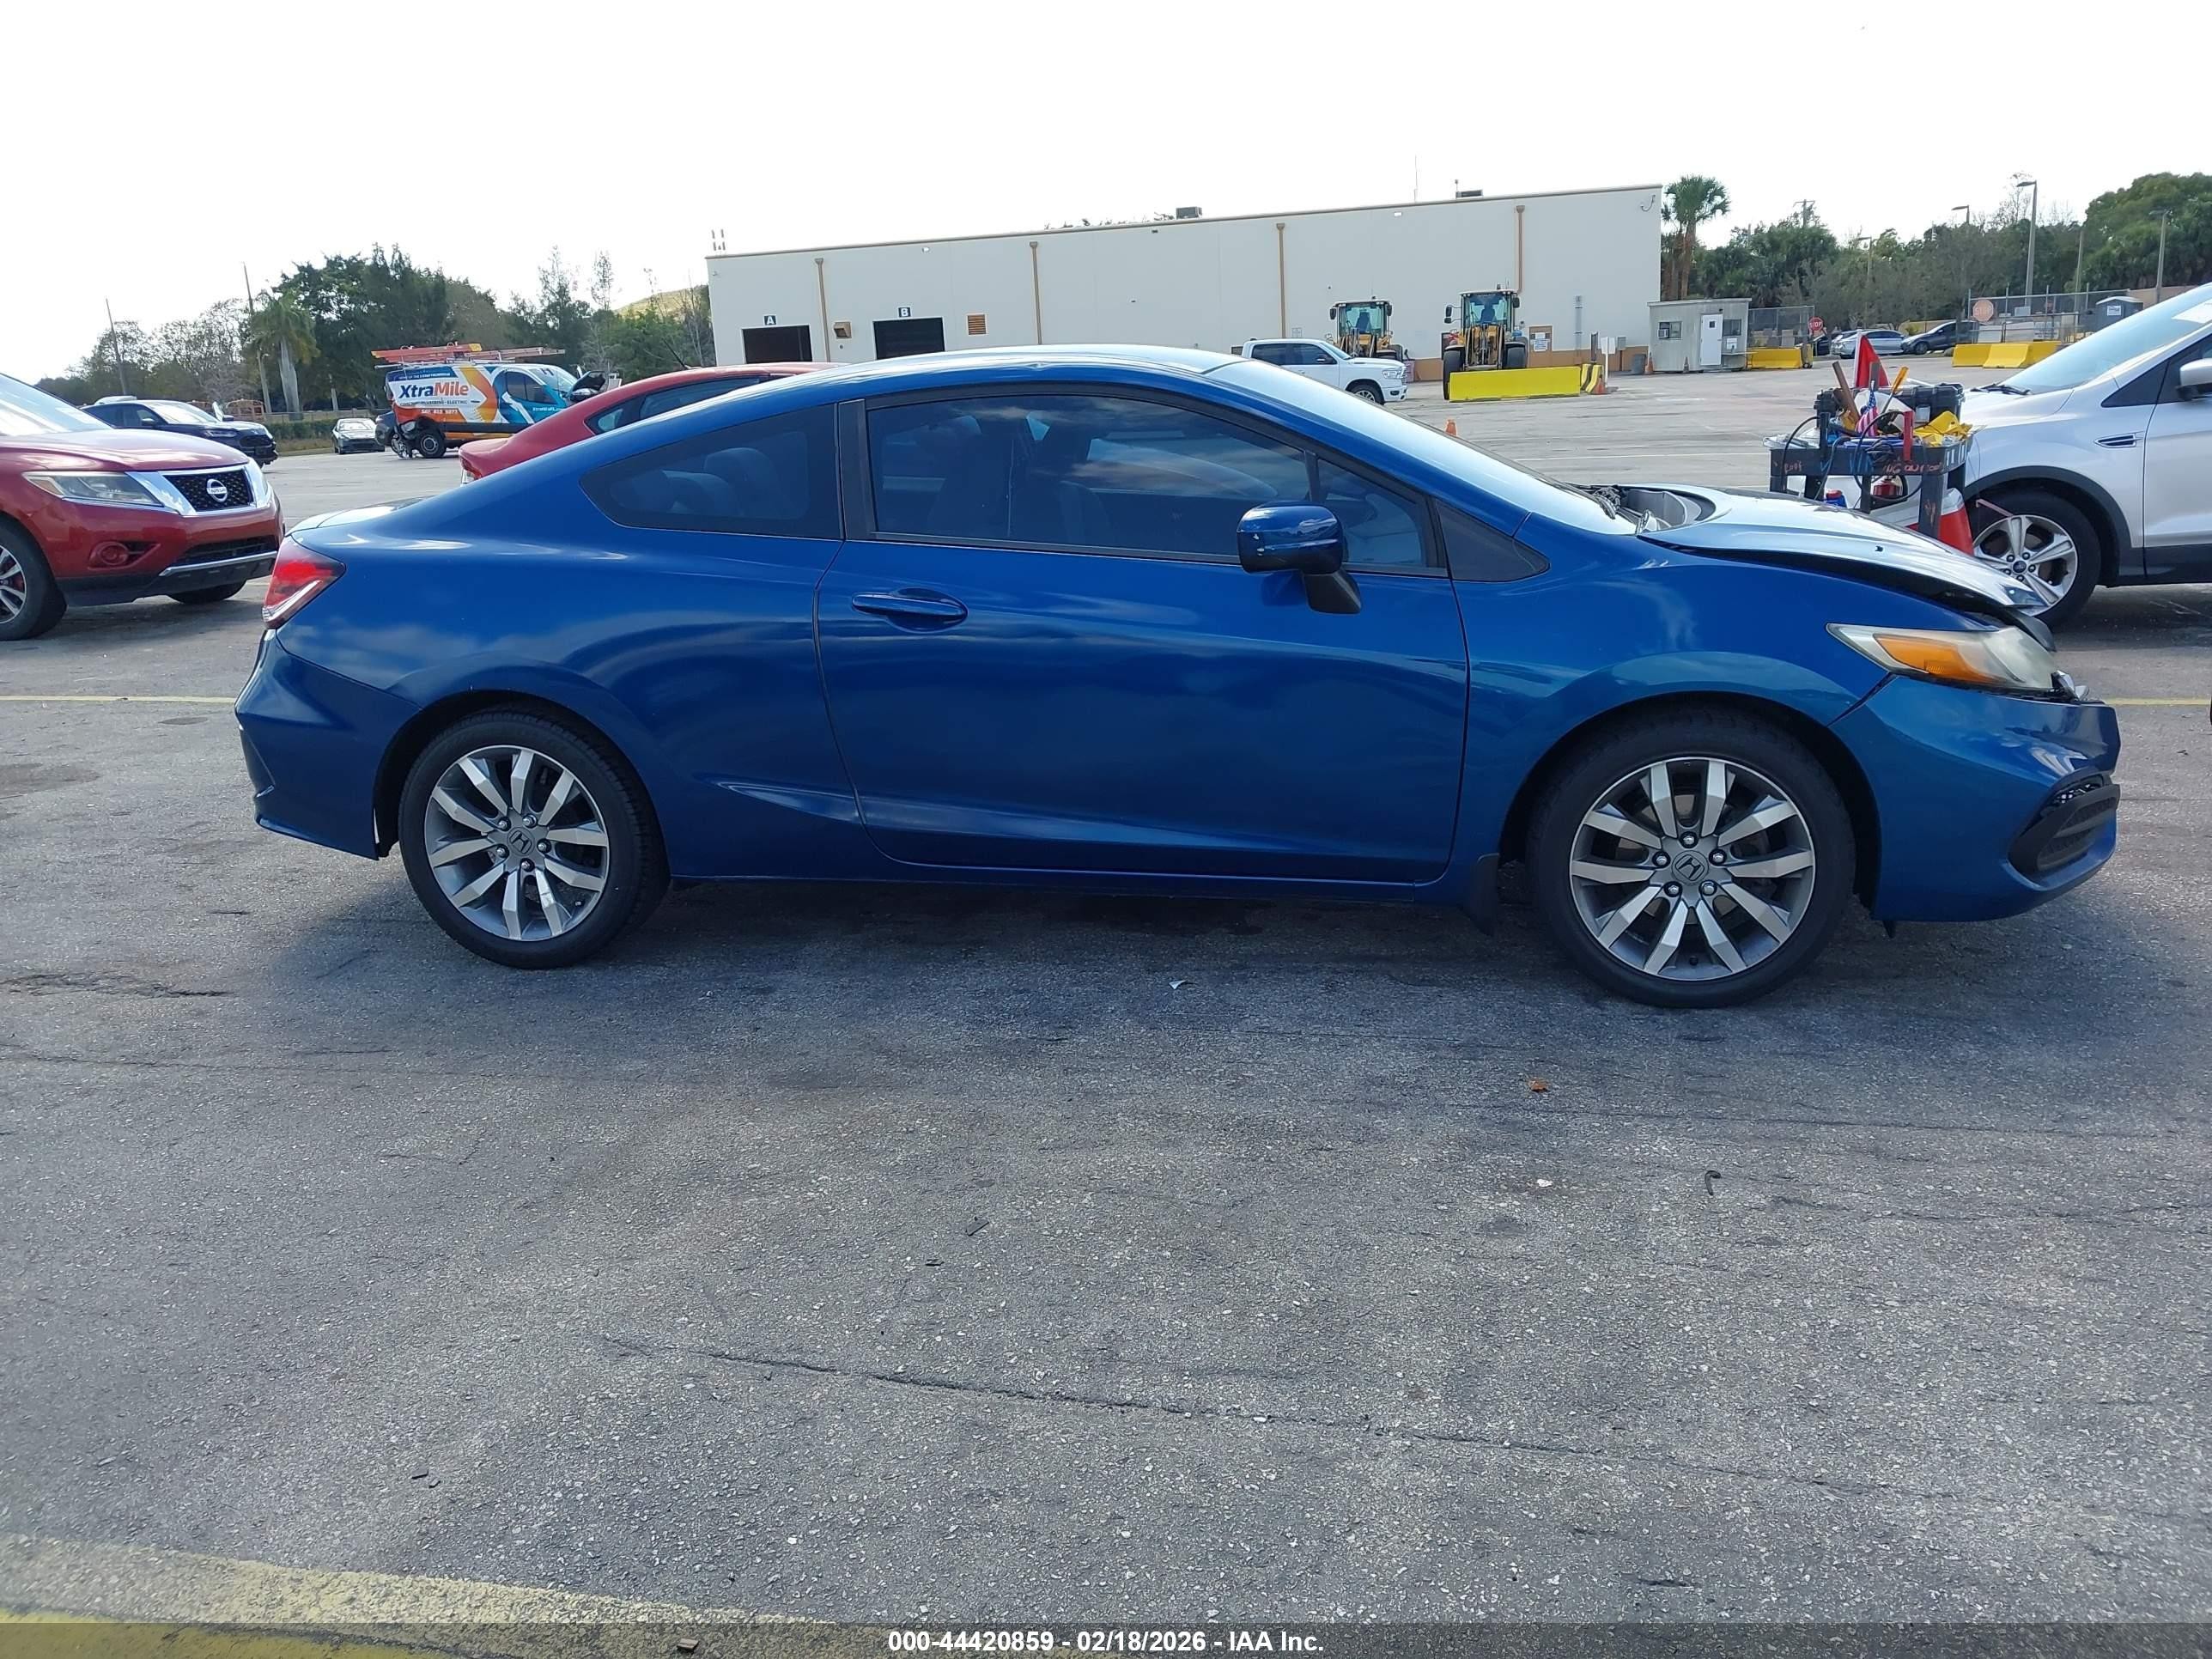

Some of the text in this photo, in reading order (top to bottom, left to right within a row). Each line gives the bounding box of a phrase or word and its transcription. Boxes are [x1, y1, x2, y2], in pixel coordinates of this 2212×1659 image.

[900, 308, 908, 317] B
[766, 315, 775, 325] A
[398, 381, 469, 398] XtraMile
